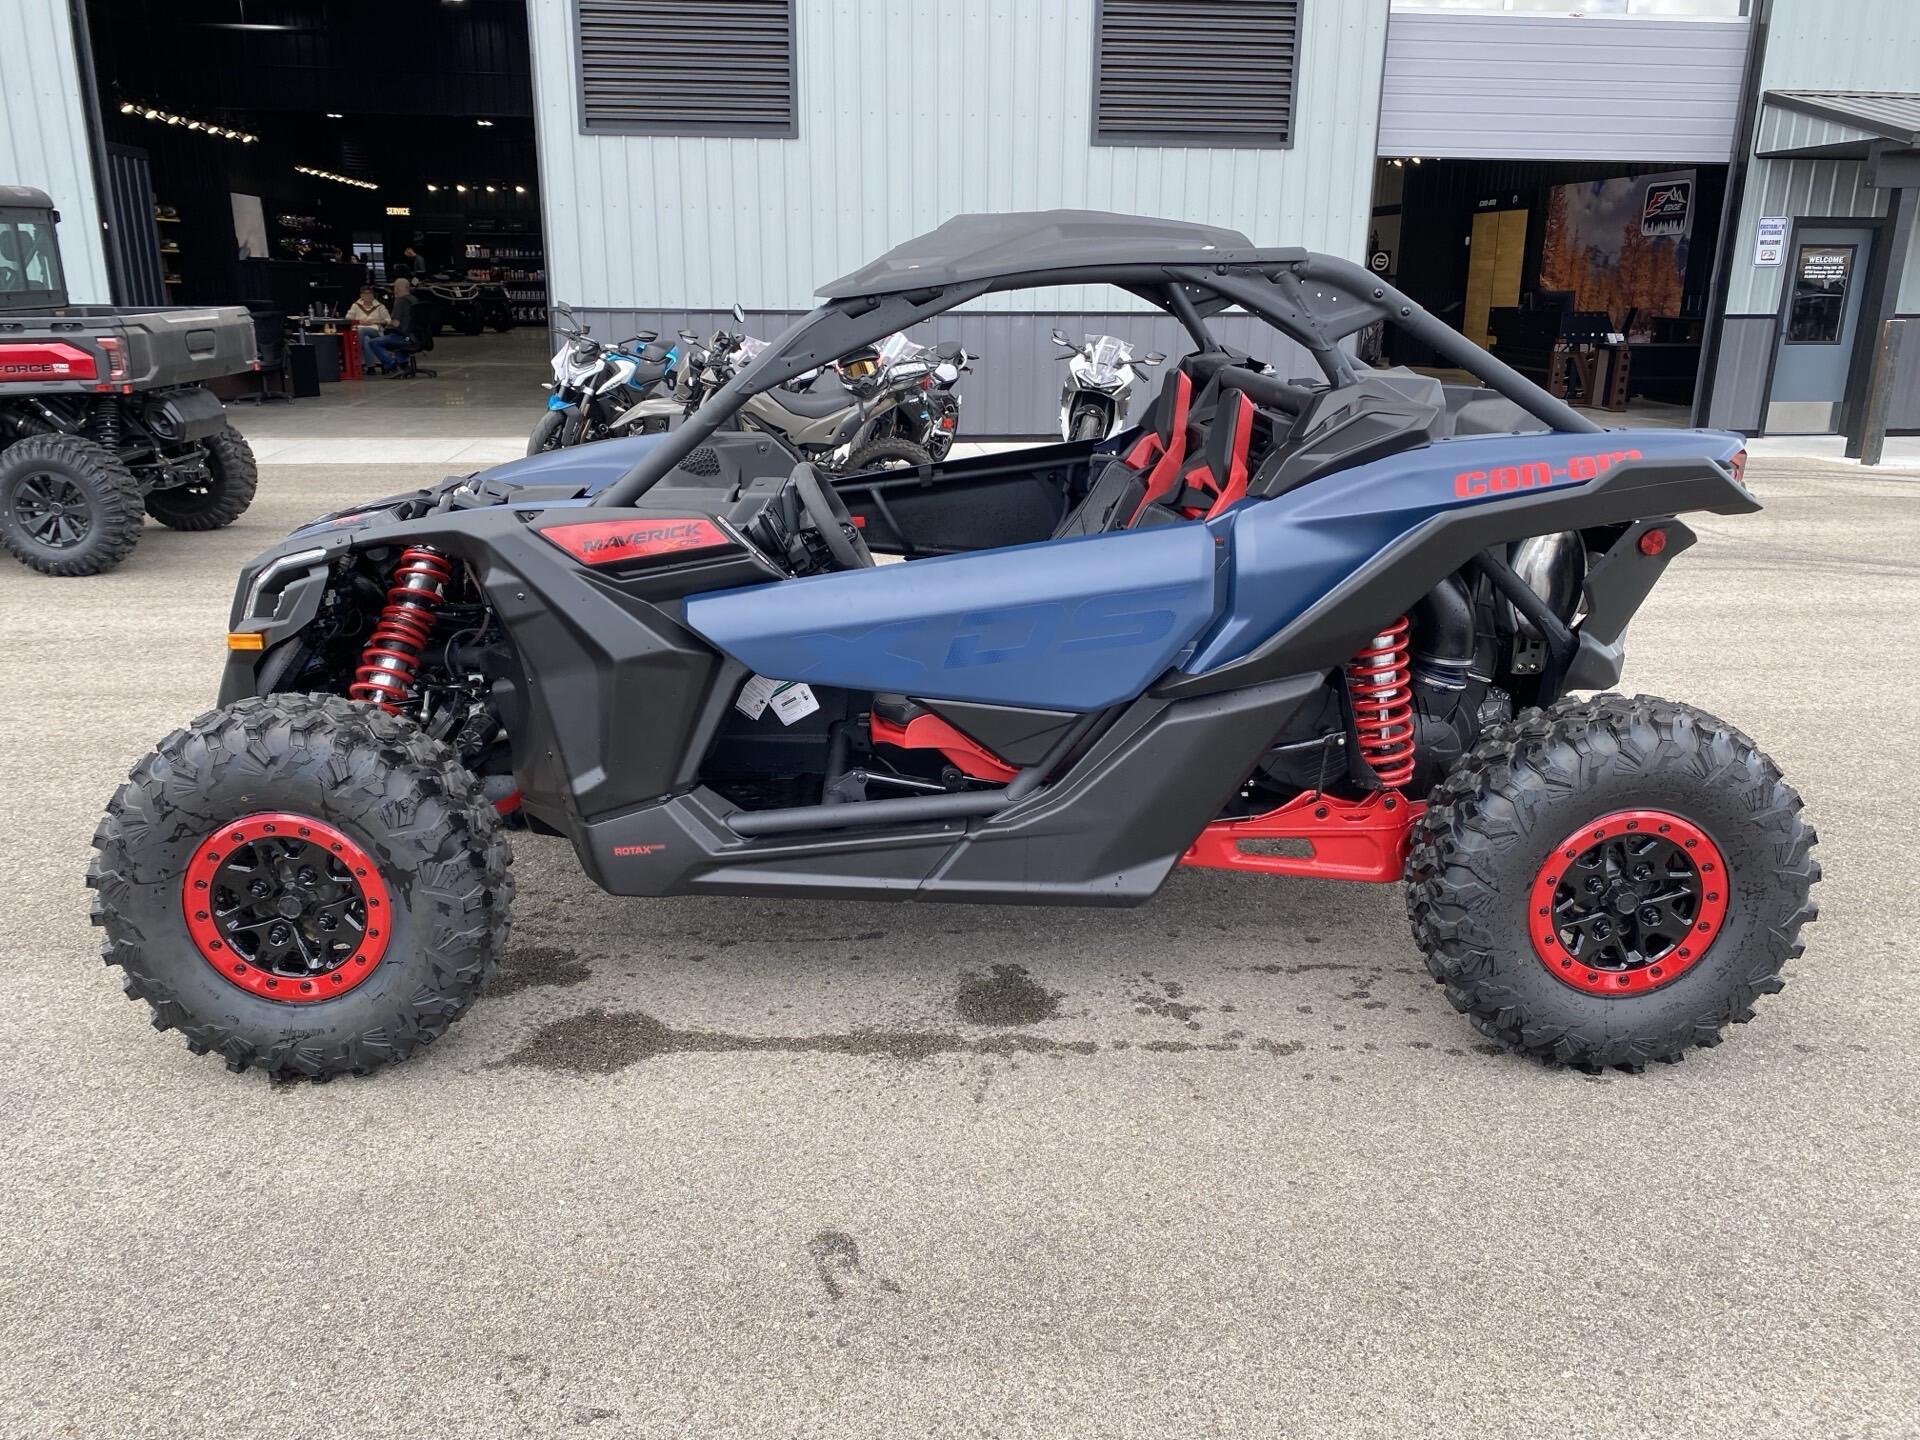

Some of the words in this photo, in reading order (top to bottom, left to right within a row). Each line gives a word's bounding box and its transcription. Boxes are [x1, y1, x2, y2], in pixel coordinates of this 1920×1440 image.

[386, 207, 410, 216] SERVICE
[1455, 449, 1643, 498] can-am
[583, 523, 701, 553] MAVERICK
[614, 845, 651, 856] ROTAX
